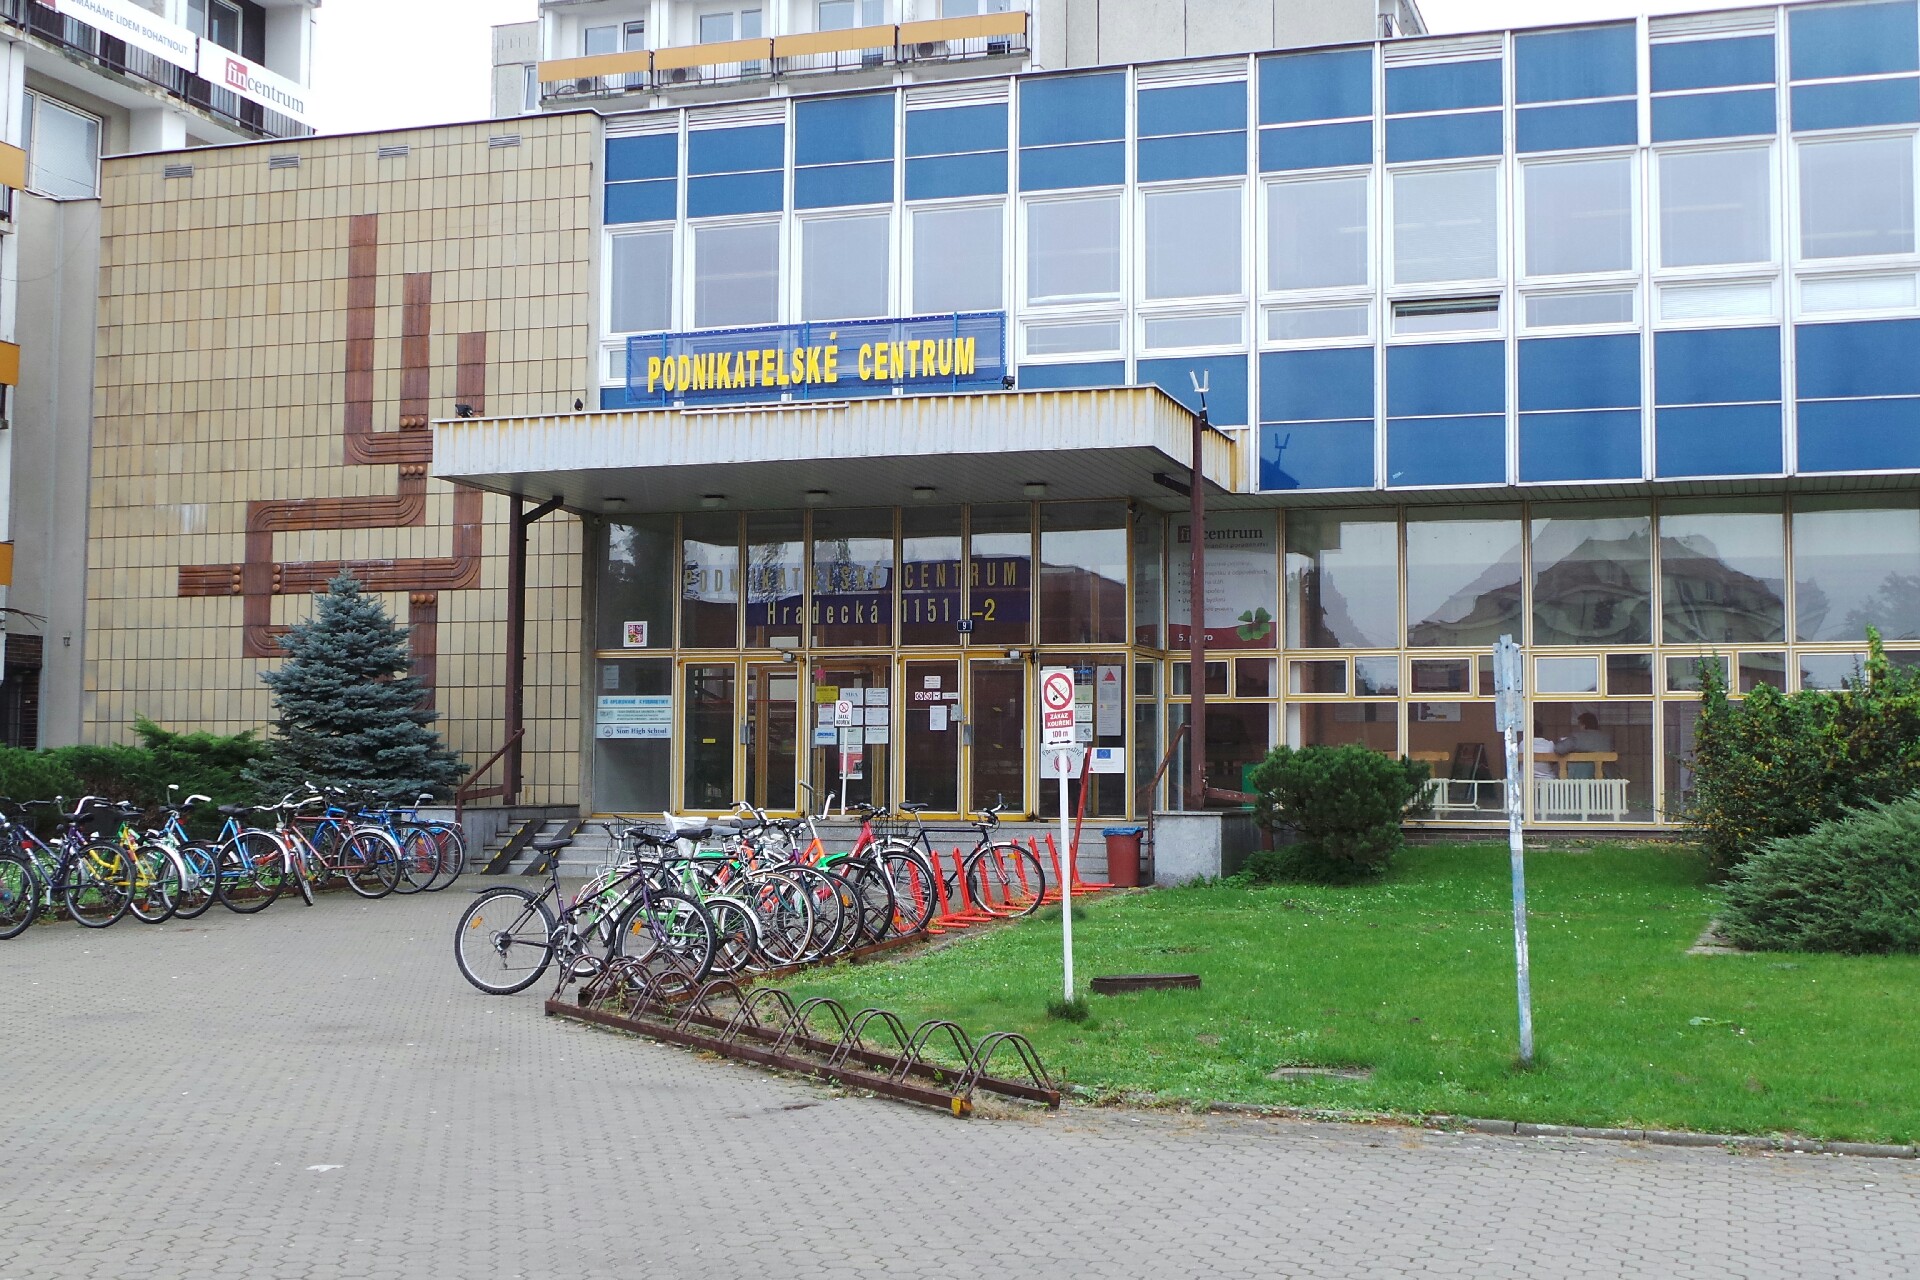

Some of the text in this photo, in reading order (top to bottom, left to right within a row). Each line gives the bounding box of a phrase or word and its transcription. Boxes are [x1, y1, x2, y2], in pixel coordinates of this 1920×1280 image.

[116, 13, 140, 33] LIDEM
[142, 26, 188, 55] BOHATNOUT
[227, 61, 304, 114] fincentrum
[647, 332, 975, 393] PODNIKATELSKÉ CENTRUM
[904, 561, 1017, 590] CENTRUM
[767, 600, 878, 625] Hradecká
[902, 597, 949, 623] 1151
[962, 621, 967, 630] 9
[1049, 712, 1069, 720] ZÁKAZ
